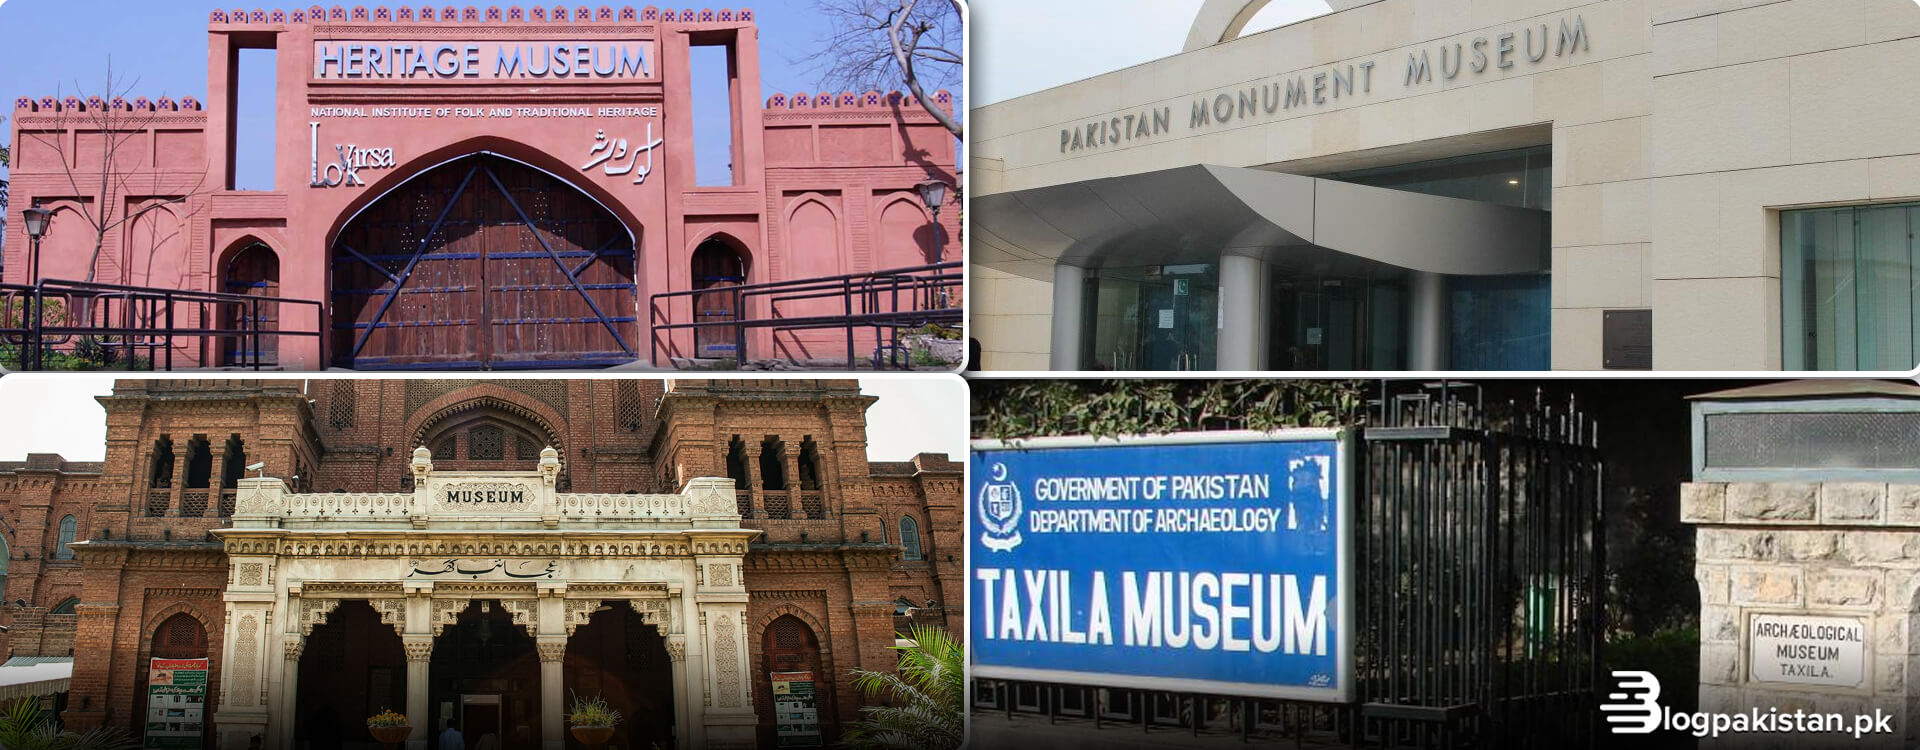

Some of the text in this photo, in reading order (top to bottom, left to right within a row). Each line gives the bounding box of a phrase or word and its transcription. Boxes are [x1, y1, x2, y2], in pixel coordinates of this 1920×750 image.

[319, 44, 649, 78] HERITAGE MUSEUM
[1060, 14, 1590, 154] PAKISTAN MONUMENT MUSEUM
[311, 107, 657, 117] NATIONAL INSTITUTE OF FOLK AND TRADITIONAL HERITAGE
[447, 490, 524, 505] MUSEUM
[1035, 474, 1270, 501] GOVERNMENT OF PAKISTAN
[1030, 507, 1281, 533] DEPARTMENT OF ARCHAEOLOGY
[976, 567, 1328, 657] TAXILA MUSEUM
[1776, 645, 1839, 661] MUSEUM
[1780, 663, 1834, 679] TAXILA.
